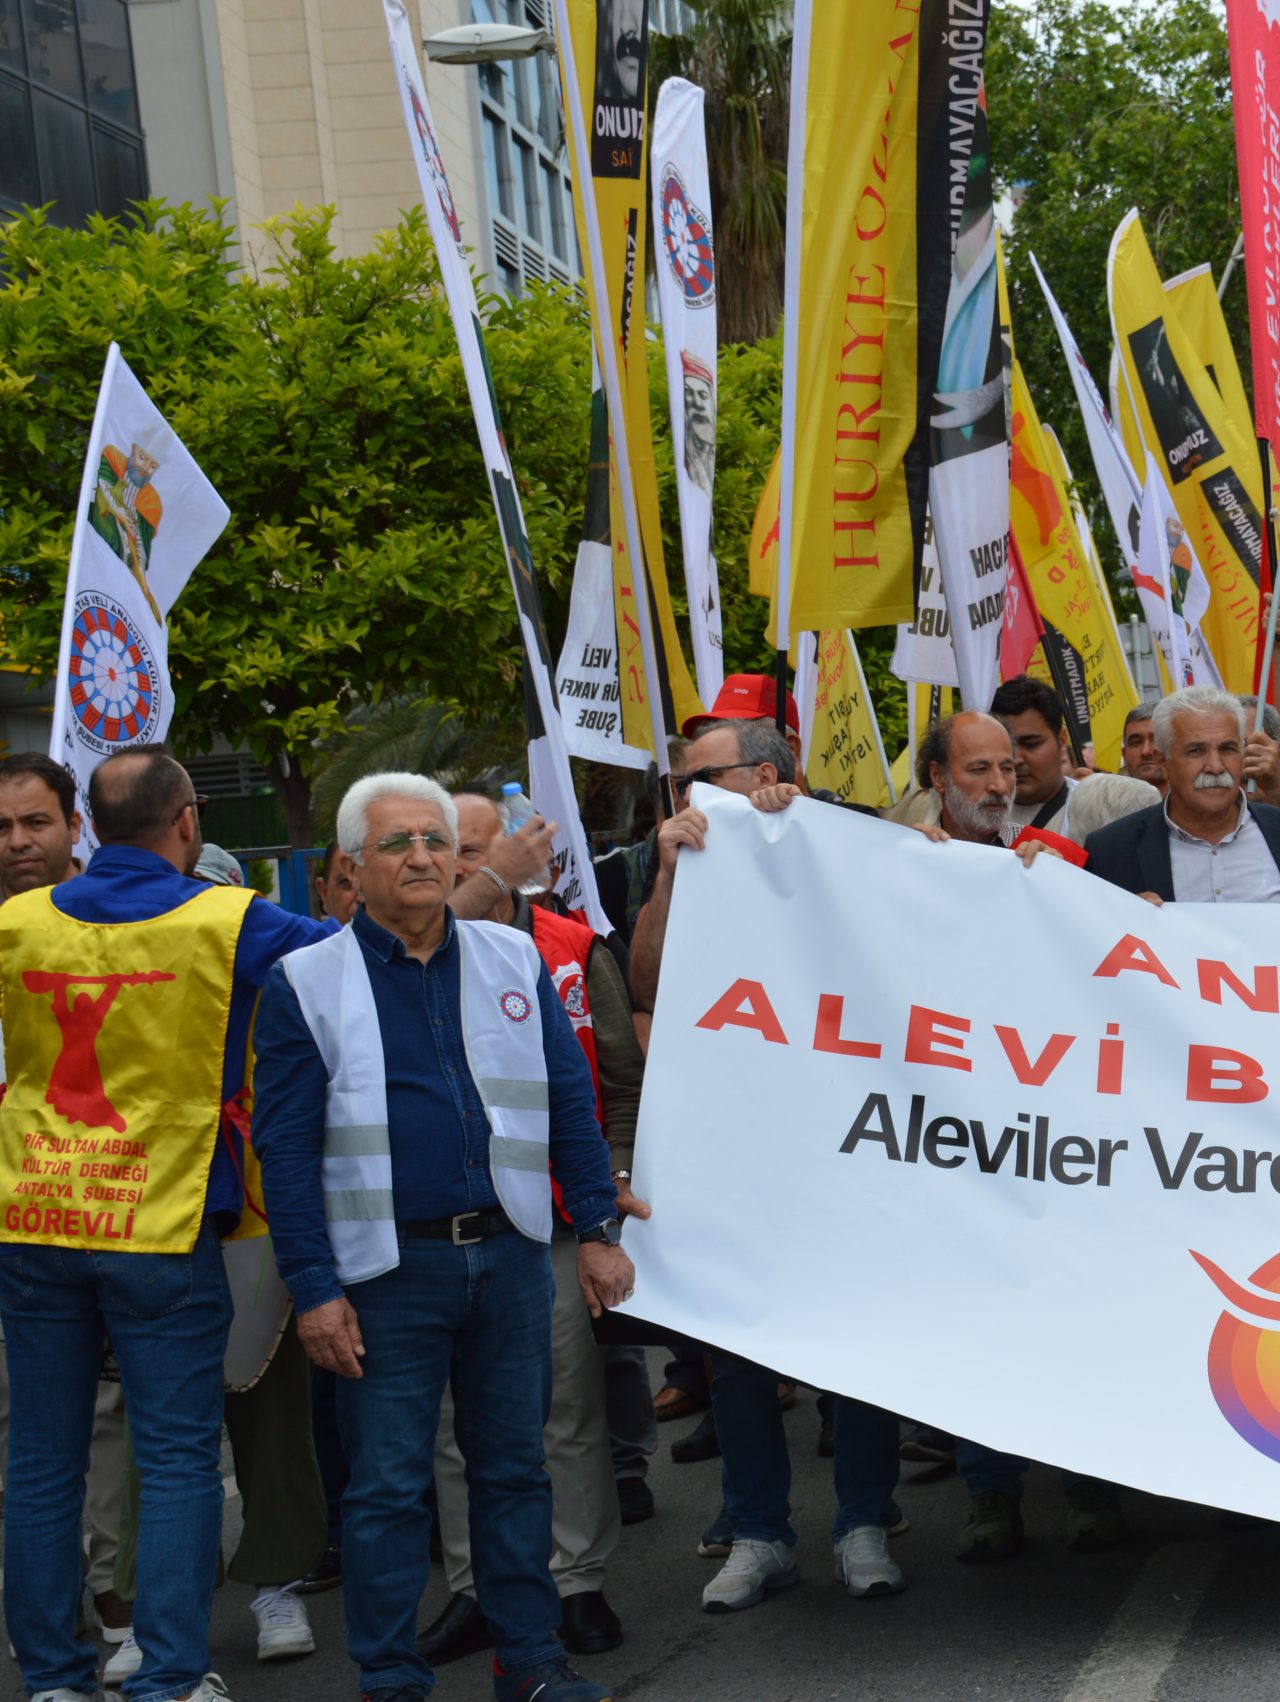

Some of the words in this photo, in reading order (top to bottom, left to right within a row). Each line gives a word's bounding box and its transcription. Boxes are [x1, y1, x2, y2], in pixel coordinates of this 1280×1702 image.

[834, 263, 886, 573] HURİYE
[110, 603, 149, 658] ANADOLU
[146, 660, 160, 715] KÜLTÜR
[1061, 645, 1090, 725] UNUTMADIK
[695, 978, 1125, 1095] ALEVİ
[21, 1156, 71, 1176] KÜLTÜR
[79, 1162, 149, 1183] DERNEĞİ
[24, 1131, 45, 1150] PİR
[48, 1136, 99, 1154] SULTAN
[100, 1138, 148, 1159] ABDAL
[838, 1092, 1128, 1187] Aleviler
[5, 1201, 136, 1240] GÖREVLİ
[13, 1181, 73, 1199] ANTALYA
[82, 1185, 143, 1204] ŞUBESİ
